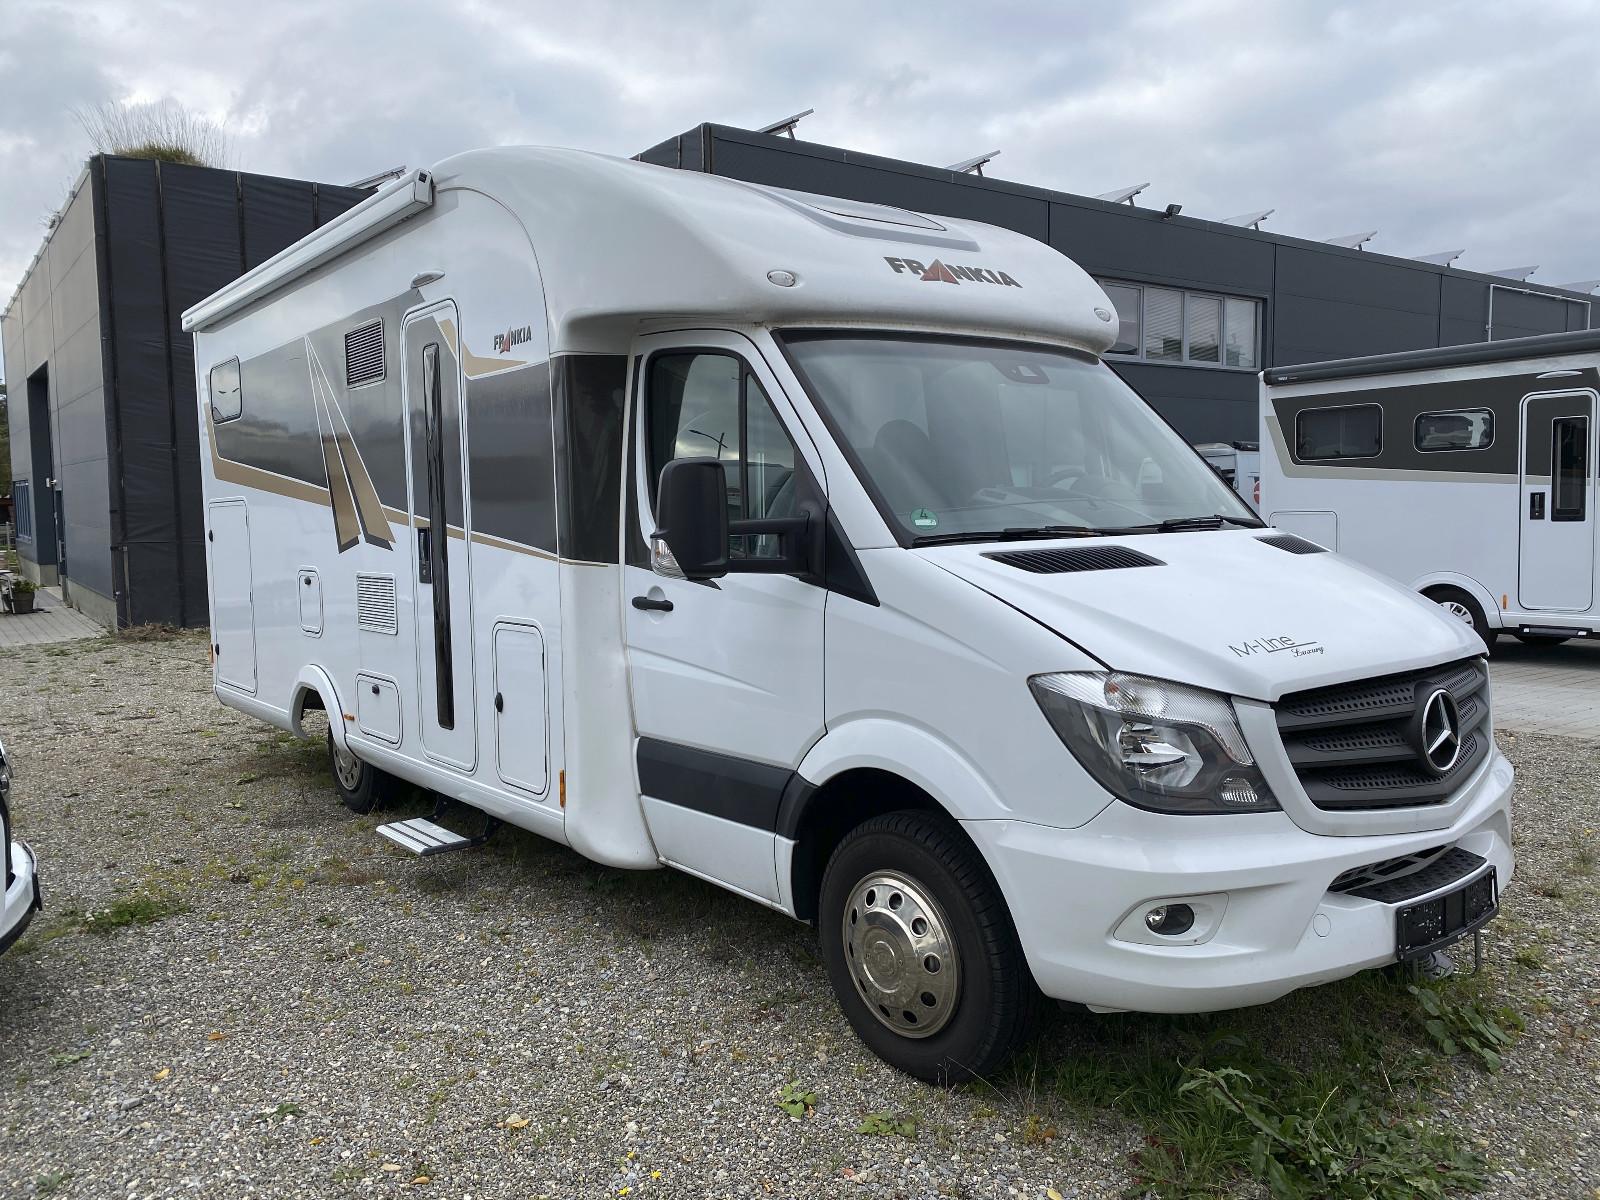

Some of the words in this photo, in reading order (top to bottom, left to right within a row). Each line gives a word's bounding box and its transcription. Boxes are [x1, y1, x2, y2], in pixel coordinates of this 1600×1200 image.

[883, 256, 1023, 288] FRANKIA
[493, 323, 532, 354] FRANKIA
[919, 508, 928, 519] 4
[1291, 646, 1325, 658] Luxury
